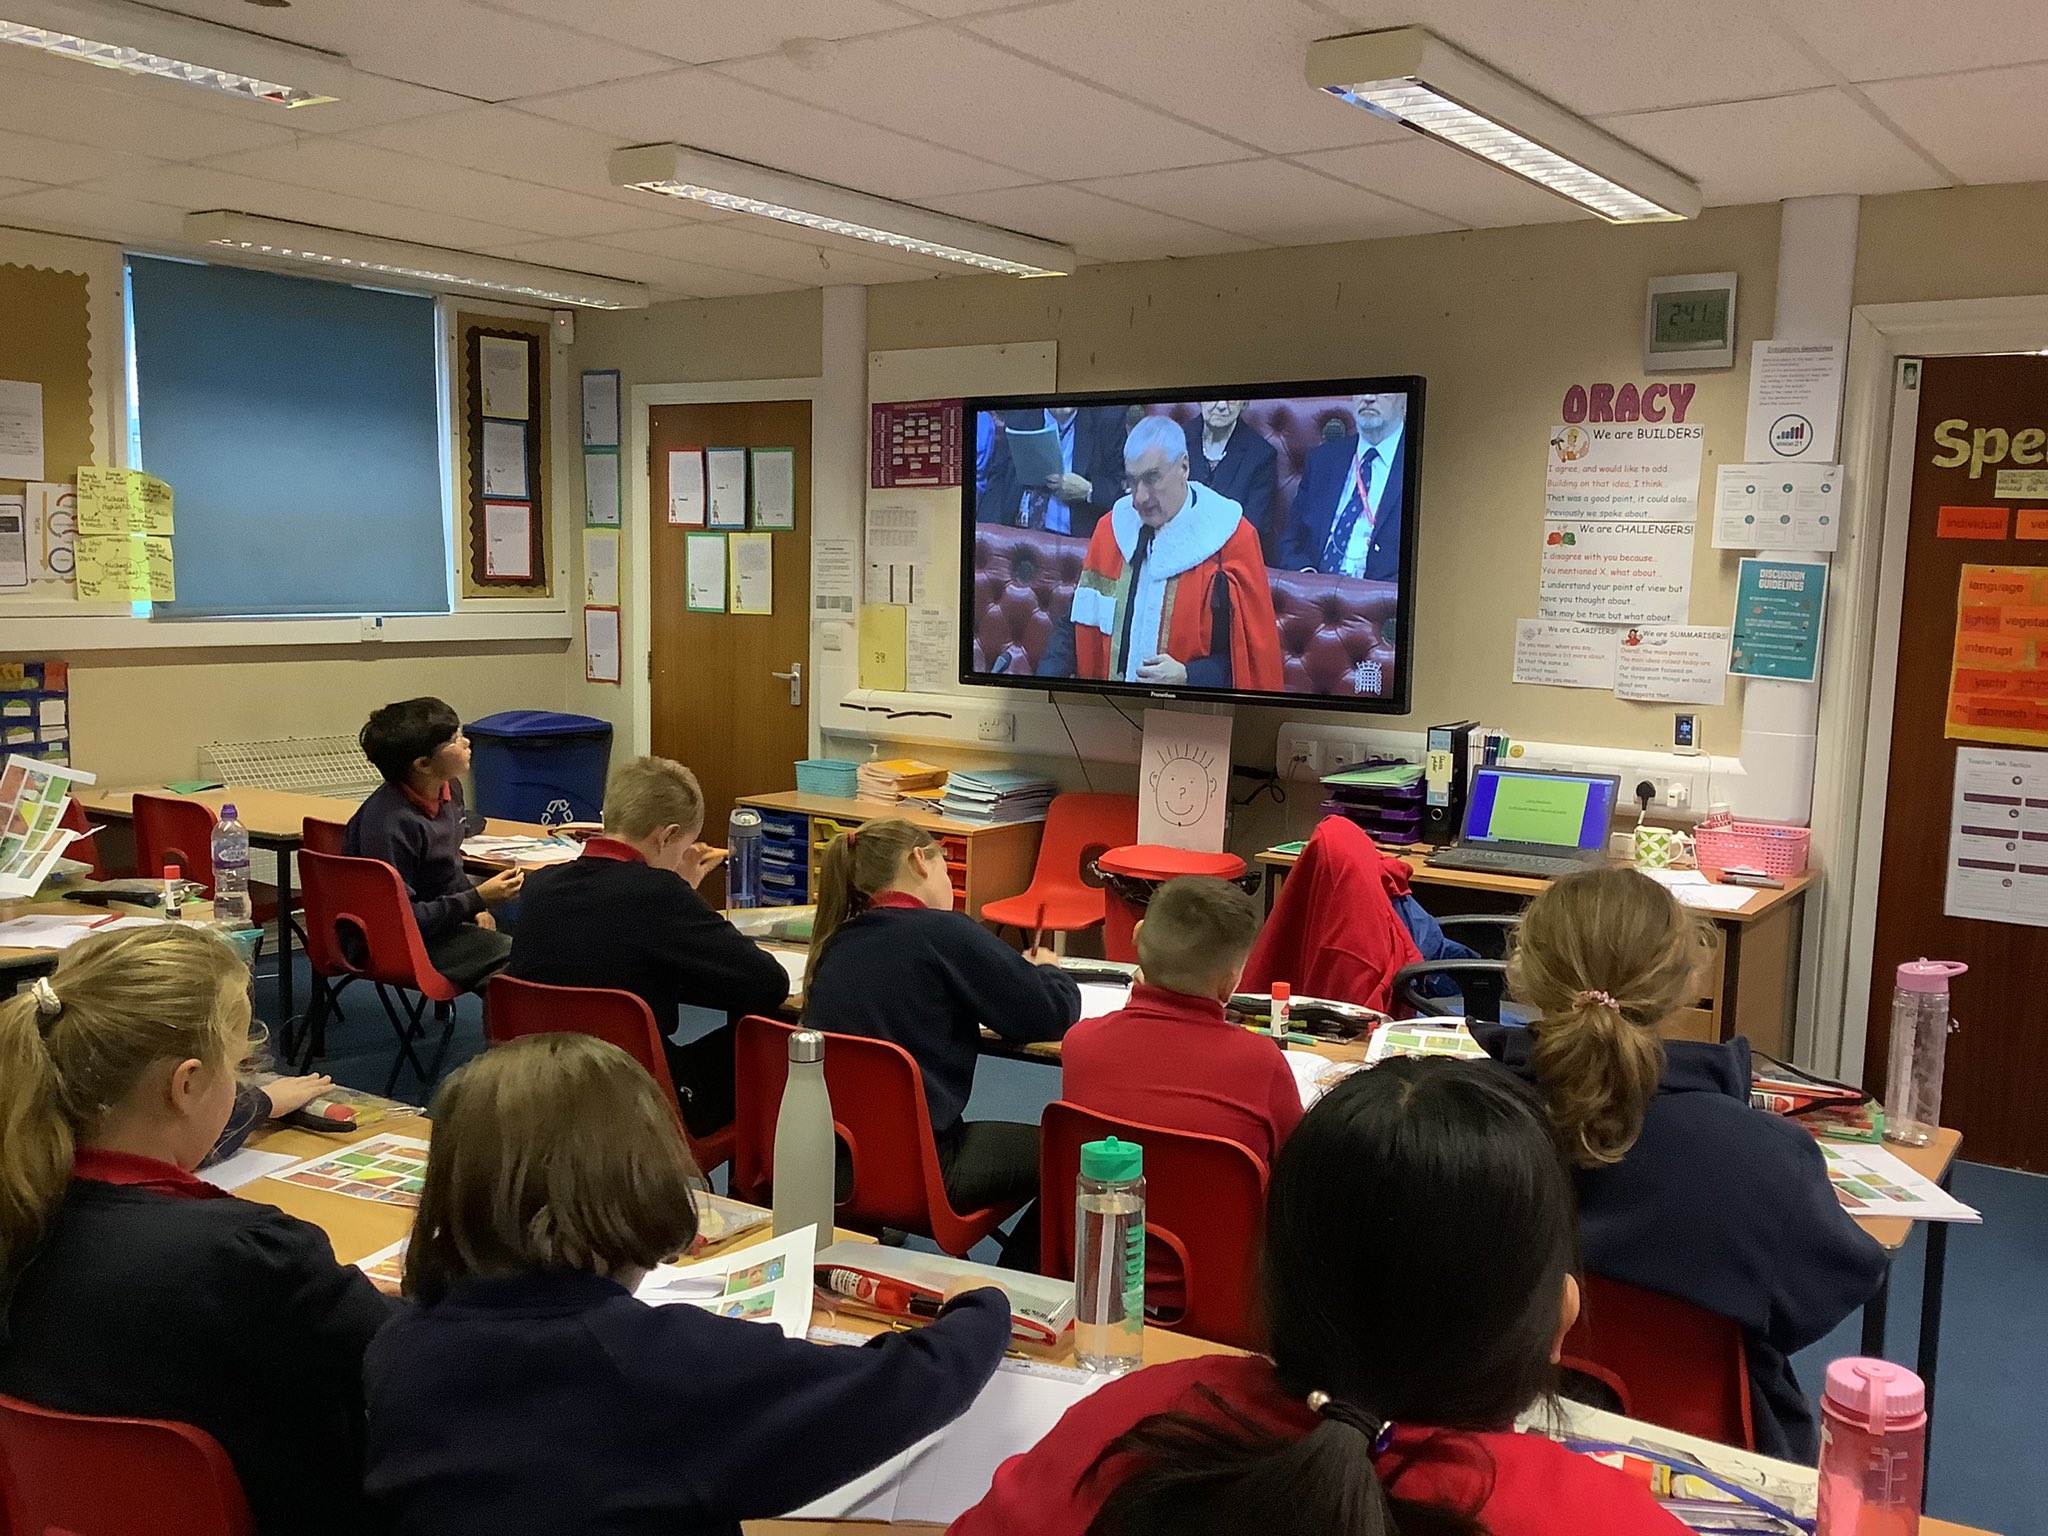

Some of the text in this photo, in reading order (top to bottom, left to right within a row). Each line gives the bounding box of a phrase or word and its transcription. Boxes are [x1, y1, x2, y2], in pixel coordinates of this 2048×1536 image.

[1562, 383, 1696, 423] ORACY
[1593, 428, 1704, 440] We are BUILDERS!
[1931, 418, 2048, 479] Spe
[1548, 465, 1553, 473] I
[1582, 465, 1597, 473] and
[1599, 465, 1622, 473] would
[1624, 465, 1639, 473] like
[1547, 479, 1578, 489] Building
[1592, 480, 1609, 488] that
[1633, 480, 1639, 488] I
[1547, 494, 1565, 502] That
[1590, 495, 1610, 504] good
[1638, 495, 1644, 503] it
[1647, 495, 1669, 503] could
[1545, 508, 1585, 518] Previously
[1600, 510, 1622, 519] spoke
[1579, 524, 1694, 535] We are CHALLENGERS!
[1946, 519, 2003, 530] individual
[1543, 552, 1547, 560] I
[1550, 552, 1582, 562] disagree
[1584, 553, 1601, 561] with
[1603, 554, 1618, 563] you
[1558, 567, 1597, 575] mentioned
[1610, 569, 1631, 577] what
[1759, 569, 1806, 580] DISCUSSION
[1547, 581, 1591, 590] understand
[1592, 584, 1611, 592] your
[1612, 583, 1633, 592] point
[1635, 583, 1645, 592] of
[1668, 584, 1683, 593] but
[1758, 580, 1805, 592] GUIDELINES
[1969, 580, 2024, 594] language
[1540, 595, 1558, 603] have
[1559, 596, 1573, 605] you
[1574, 595, 1606, 606] thought
[1540, 608, 1557, 617] That
[1559, 610, 1574, 619] may
[1576, 610, 1586, 618] be
[1588, 611, 1606, 619] true
[1608, 612, 1622, 620] but
[1623, 613, 1644, 621] what
[1964, 643, 2013, 657] interrupt
[1974, 678, 2007, 689] yacht
[1976, 707, 2027, 719] stomach
